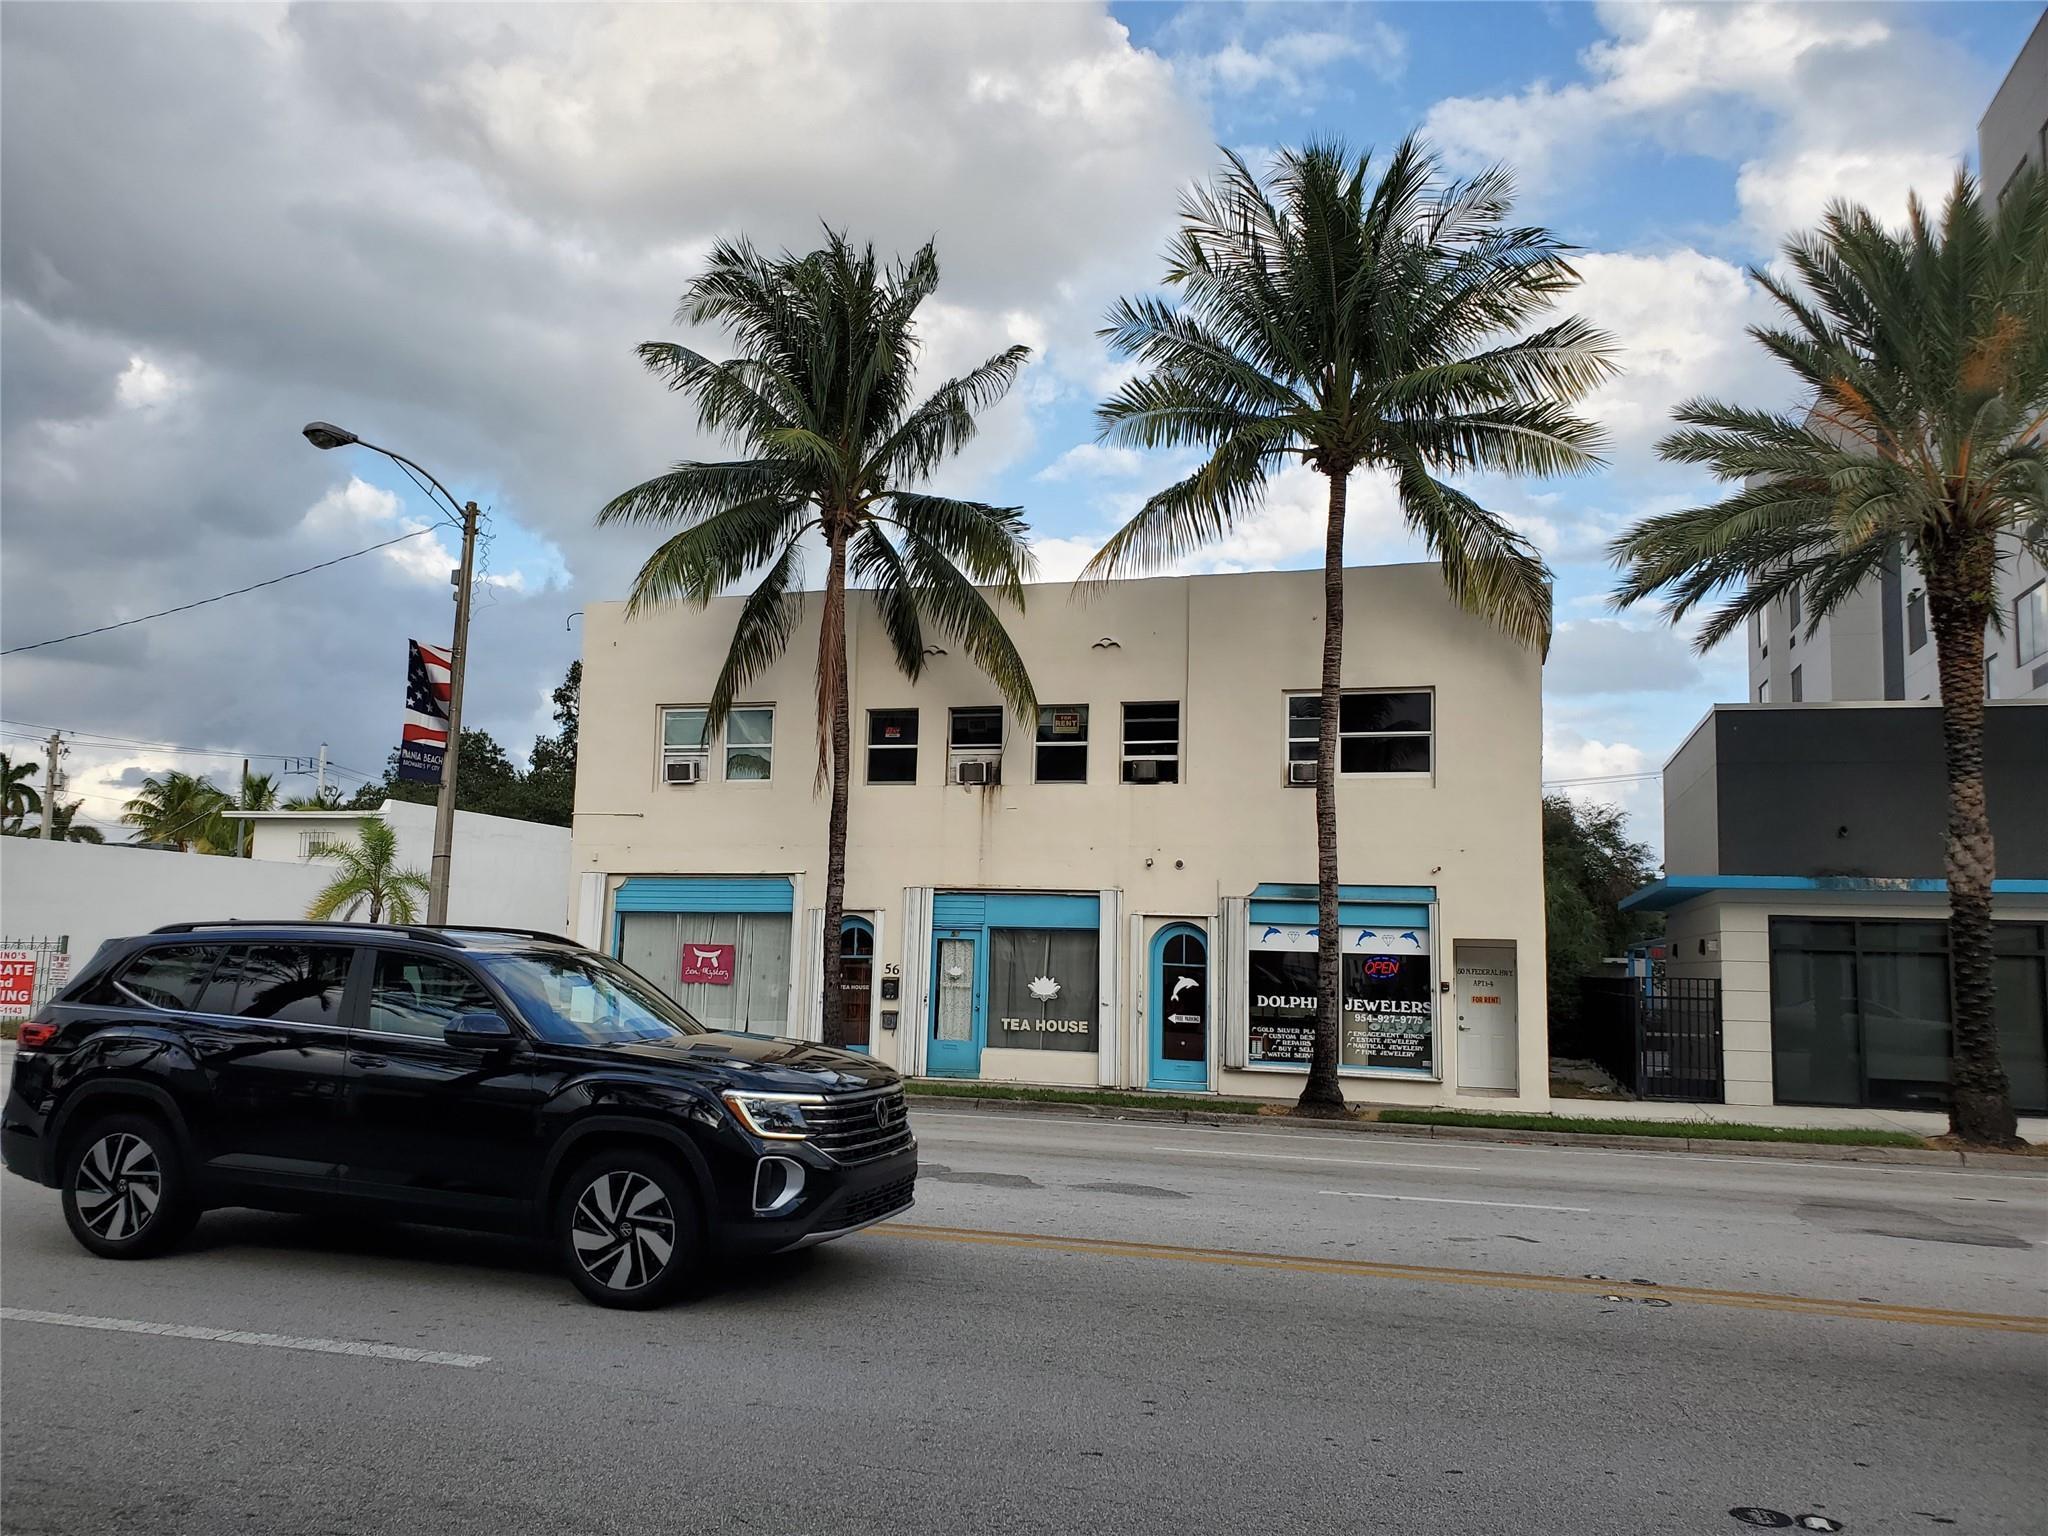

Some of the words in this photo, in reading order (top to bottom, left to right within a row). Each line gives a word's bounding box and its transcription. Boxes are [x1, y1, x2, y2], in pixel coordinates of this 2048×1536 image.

[402, 749, 421, 761] DANIA
[423, 753, 443, 765] BEACH
[884, 963, 900, 975] 56
[1365, 961, 1399, 974] OPEN
[1471, 968, 1498, 976] FEDERAL
[1257, 994, 1318, 1009] DOLPHI
[1344, 997, 1431, 1014] JEWELERS
[1472, 996, 1483, 1004] FOR
[1484, 996, 1499, 1004] RENT
[1354, 1013, 1424, 1025] 954-927-9775
[1001, 1018, 1031, 1031] TEA
[1035, 1019, 1089, 1034] HOUSE
[1353, 1031, 1400, 1039] ENGAGEMENT
